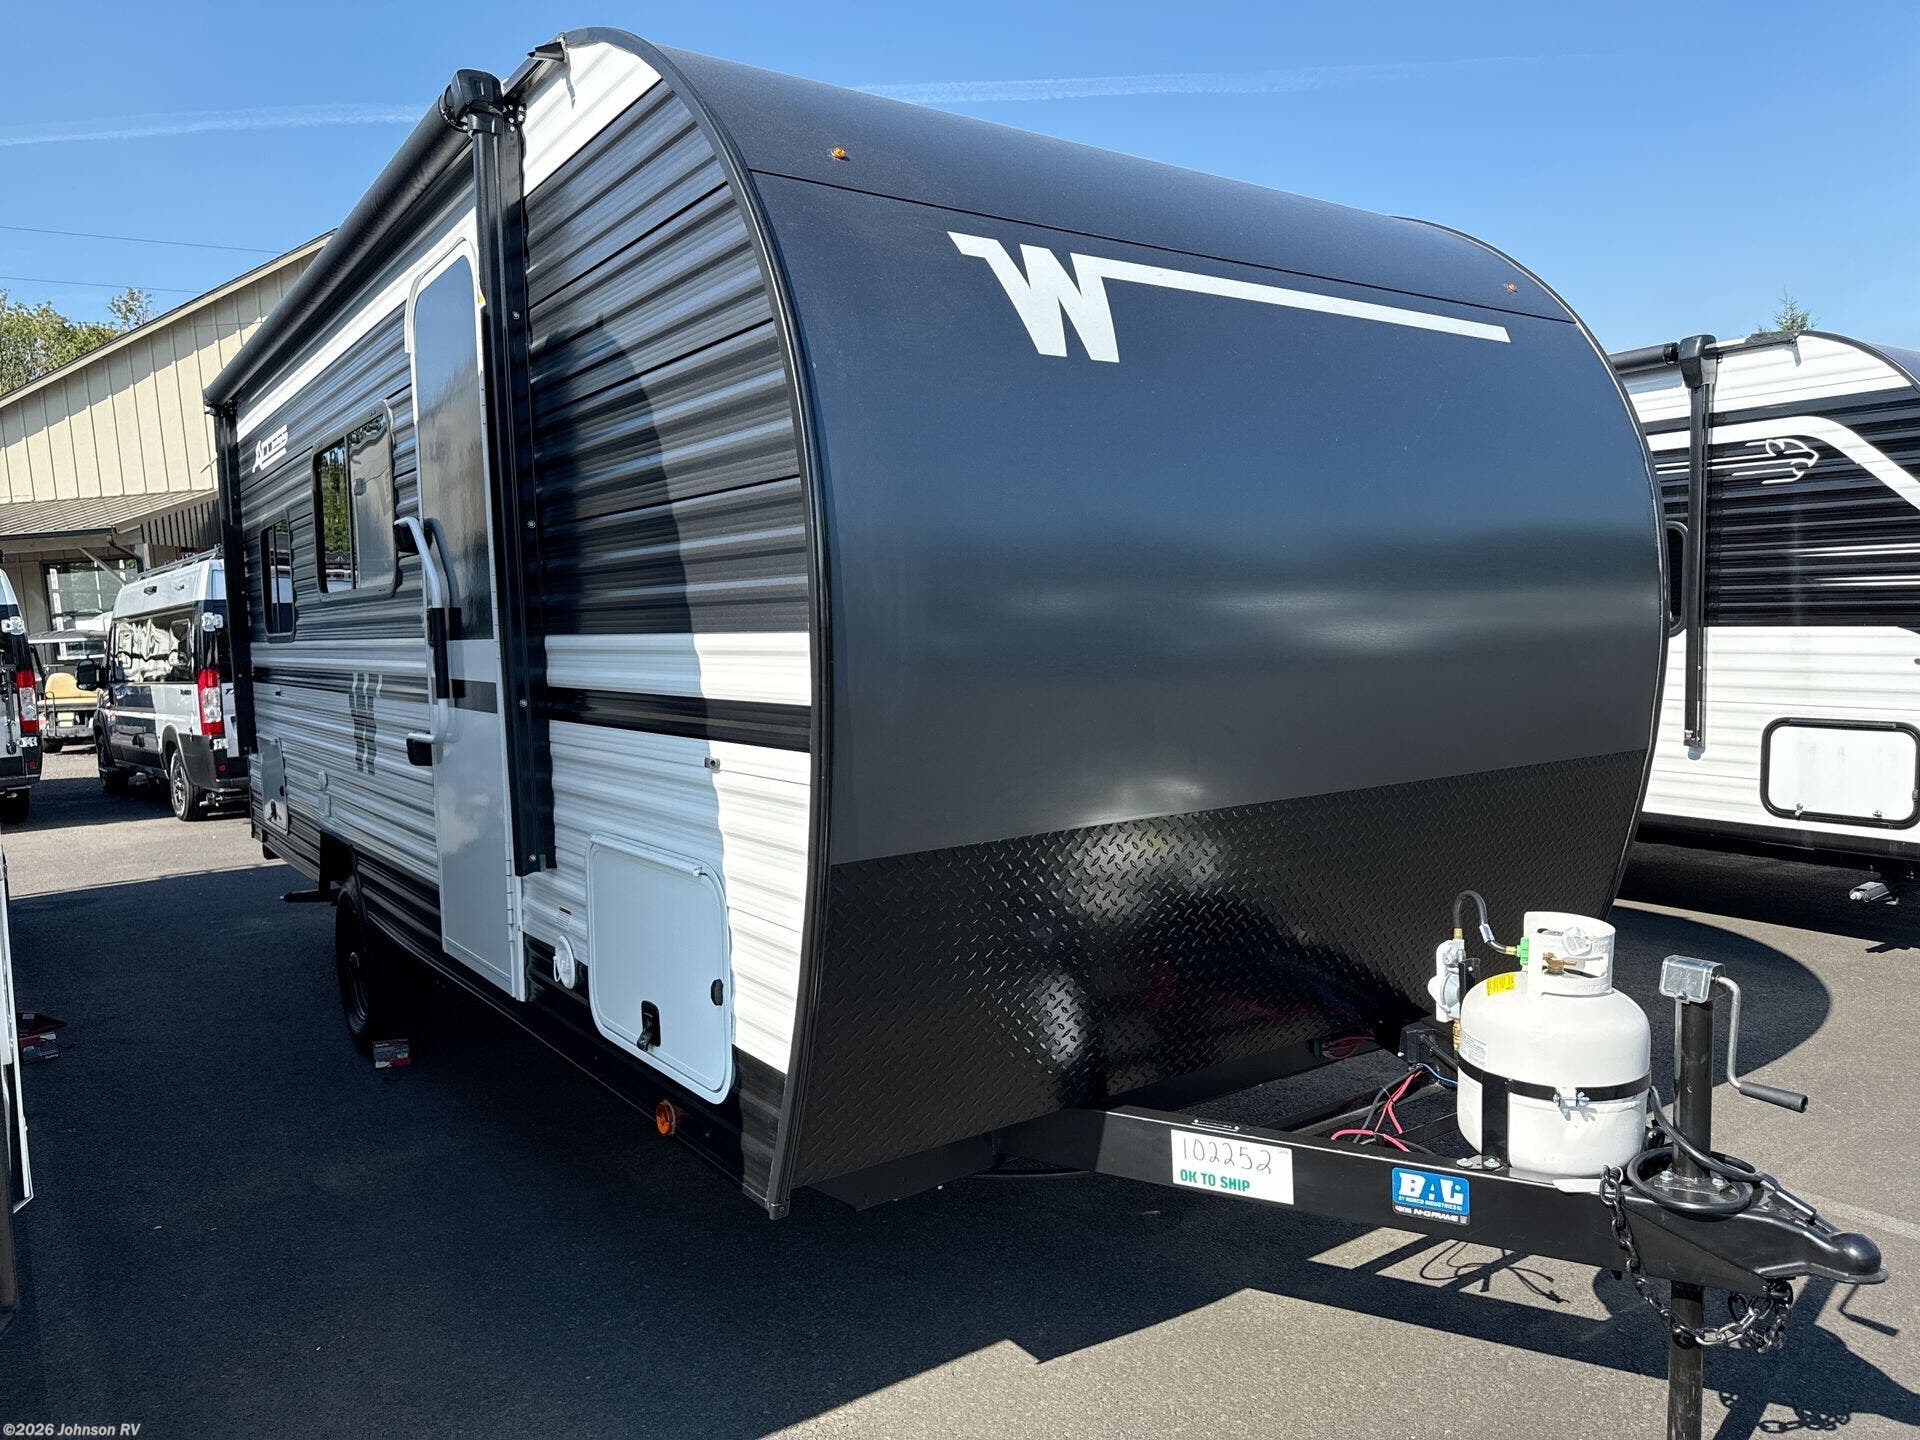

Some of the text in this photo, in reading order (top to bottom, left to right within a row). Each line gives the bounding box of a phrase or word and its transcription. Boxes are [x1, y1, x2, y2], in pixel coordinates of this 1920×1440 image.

[1183, 1137, 1271, 1175] 102252
[1180, 1169, 1250, 1192] OK TO SHIP
[1399, 1172, 1463, 1205] BAL
